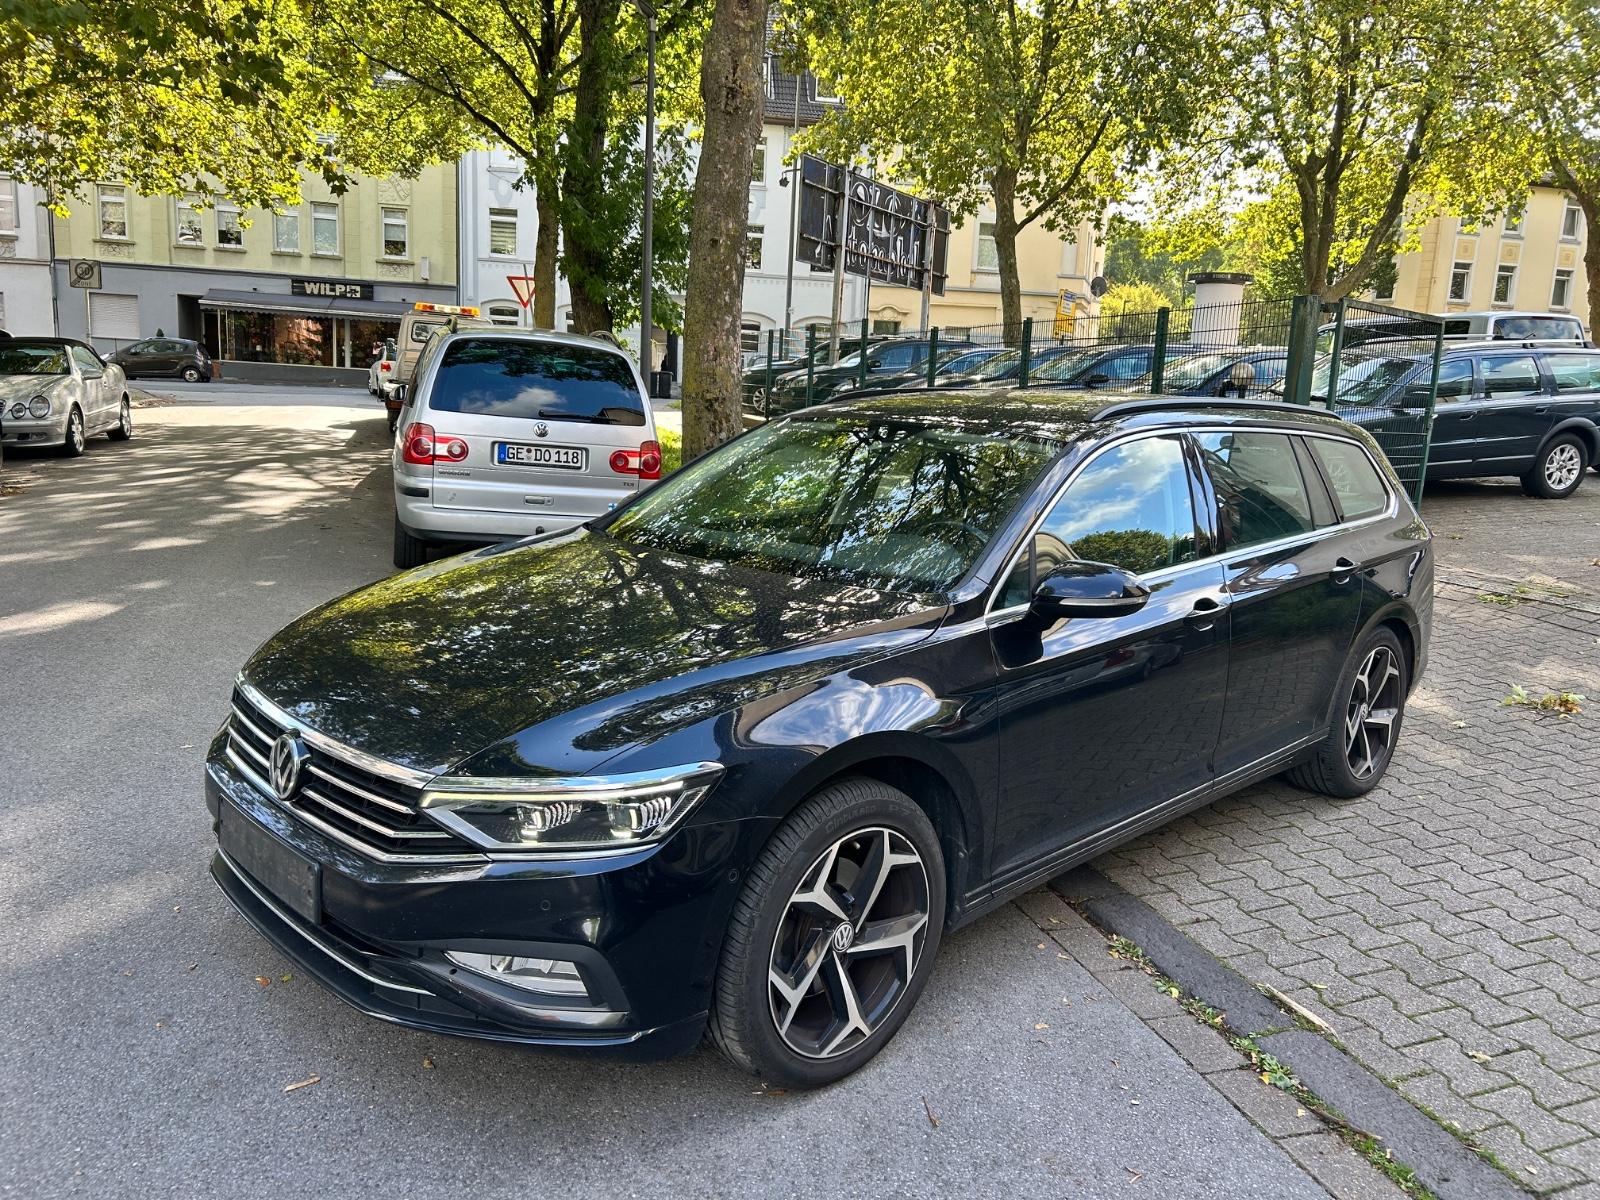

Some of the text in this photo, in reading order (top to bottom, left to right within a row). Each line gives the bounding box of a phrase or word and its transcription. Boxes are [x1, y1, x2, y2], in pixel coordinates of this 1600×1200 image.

[78, 266, 90, 276] 30
[506, 446, 525, 461] GE
[534, 448, 552, 463] DO
[555, 450, 579, 464] 118
